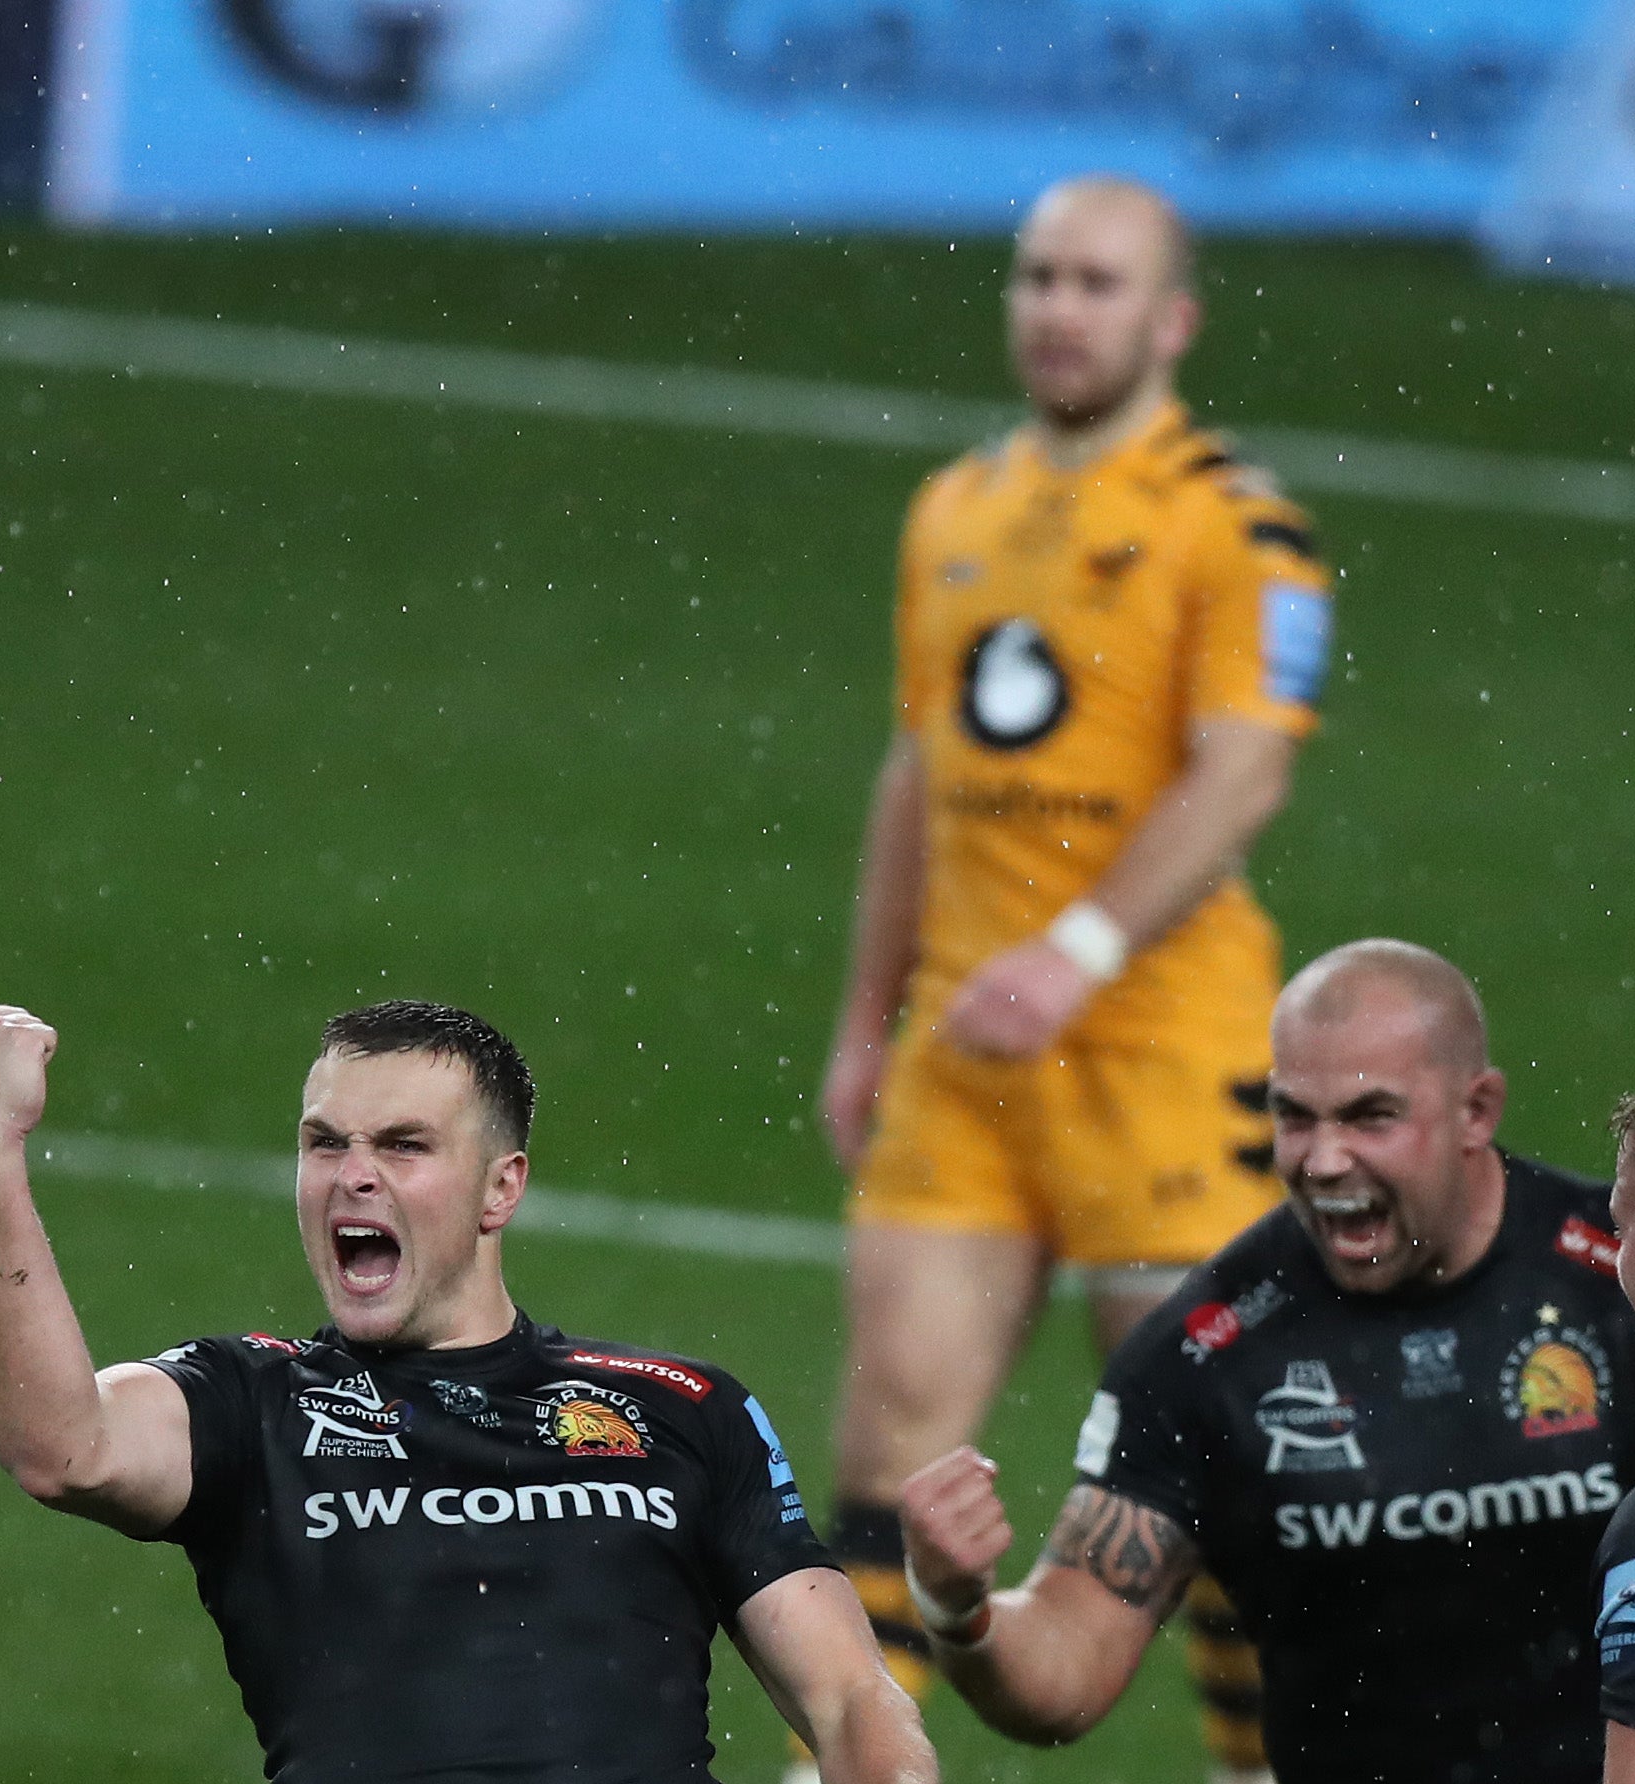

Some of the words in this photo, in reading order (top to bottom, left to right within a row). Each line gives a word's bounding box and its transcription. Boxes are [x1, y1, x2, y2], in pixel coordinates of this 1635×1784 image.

[344, 1373, 369, 1391] 25
[609, 1359, 703, 1393] WATSON
[321, 1437, 389, 1451] SUPPORTING
[319, 1446, 344, 1457] THE
[349, 1447, 392, 1459] CHIEFS
